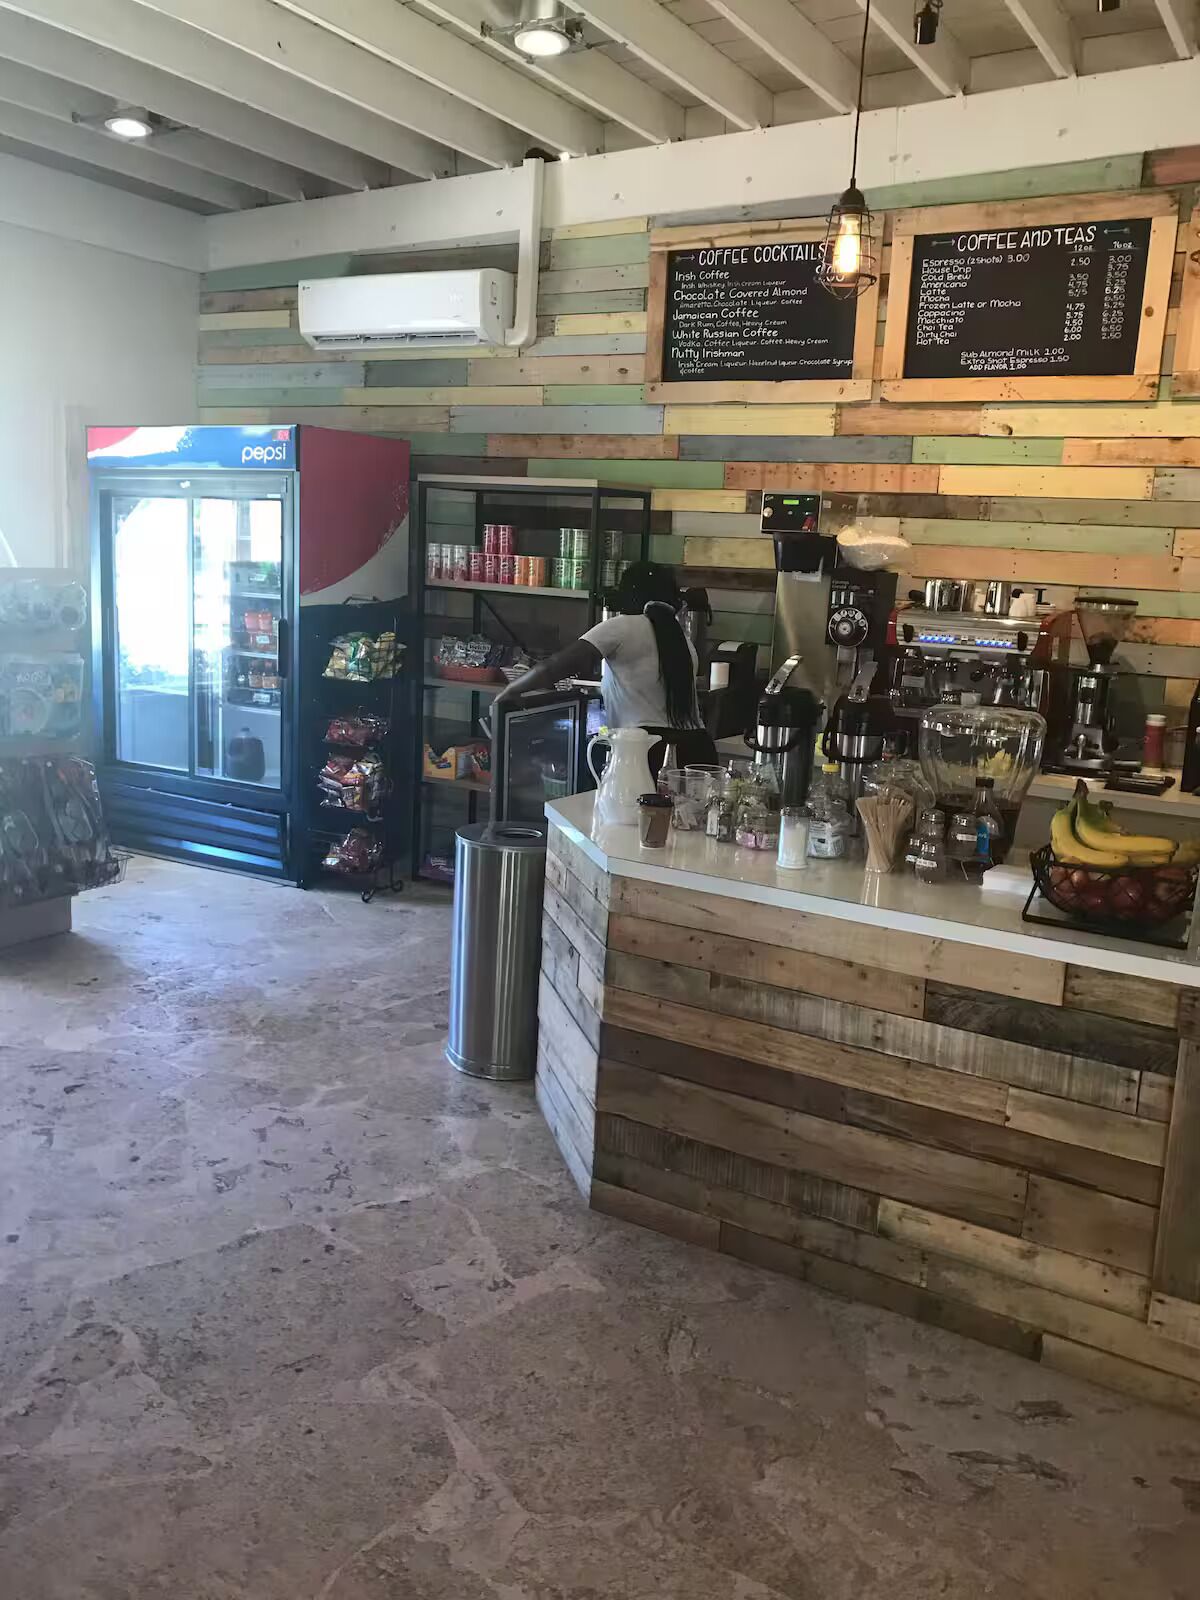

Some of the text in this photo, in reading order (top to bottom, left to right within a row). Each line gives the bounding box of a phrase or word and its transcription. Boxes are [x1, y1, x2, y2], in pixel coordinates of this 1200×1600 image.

[957, 225, 1097, 252] COFFEE AND TEAS
[698, 242, 829, 267] COFFEE COCKTAILS
[922, 257, 965, 268] Espresso
[1007, 253, 1030, 262] 3.00
[1070, 257, 1091, 267] 2.50
[922, 265, 972, 275] House Drip
[675, 269, 731, 282] Irish Coffee
[921, 273, 971, 282] Cold Brew
[674, 286, 808, 301] Chocolate Covered Almond
[920, 288, 946, 296] Latte
[919, 302, 950, 310] Frozen
[951, 301, 975, 309] Latte
[989, 299, 1021, 308] Mocha
[1066, 302, 1086, 311] 4.75
[673, 307, 759, 321] Jamaican Coffee
[917, 317, 964, 325] Macchiato
[939, 323, 954, 331] Tea
[672, 328, 778, 339] White Russian Coffee
[917, 331, 938, 340] Dirty
[1063, 333, 1082, 341] 2.00
[916, 338, 932, 346] Hot
[671, 347, 745, 362] Nutty Irishman
[960, 350, 978, 359] Sub
[979, 348, 1014, 358] Almond
[1044, 348, 1065, 356] 1.00
[960, 357, 985, 366] Extra
[987, 357, 1007, 365] Shot
[1009, 356, 1048, 365] Espresso
[968, 363, 983, 371] ADD
[241, 442, 287, 464] pepsi
